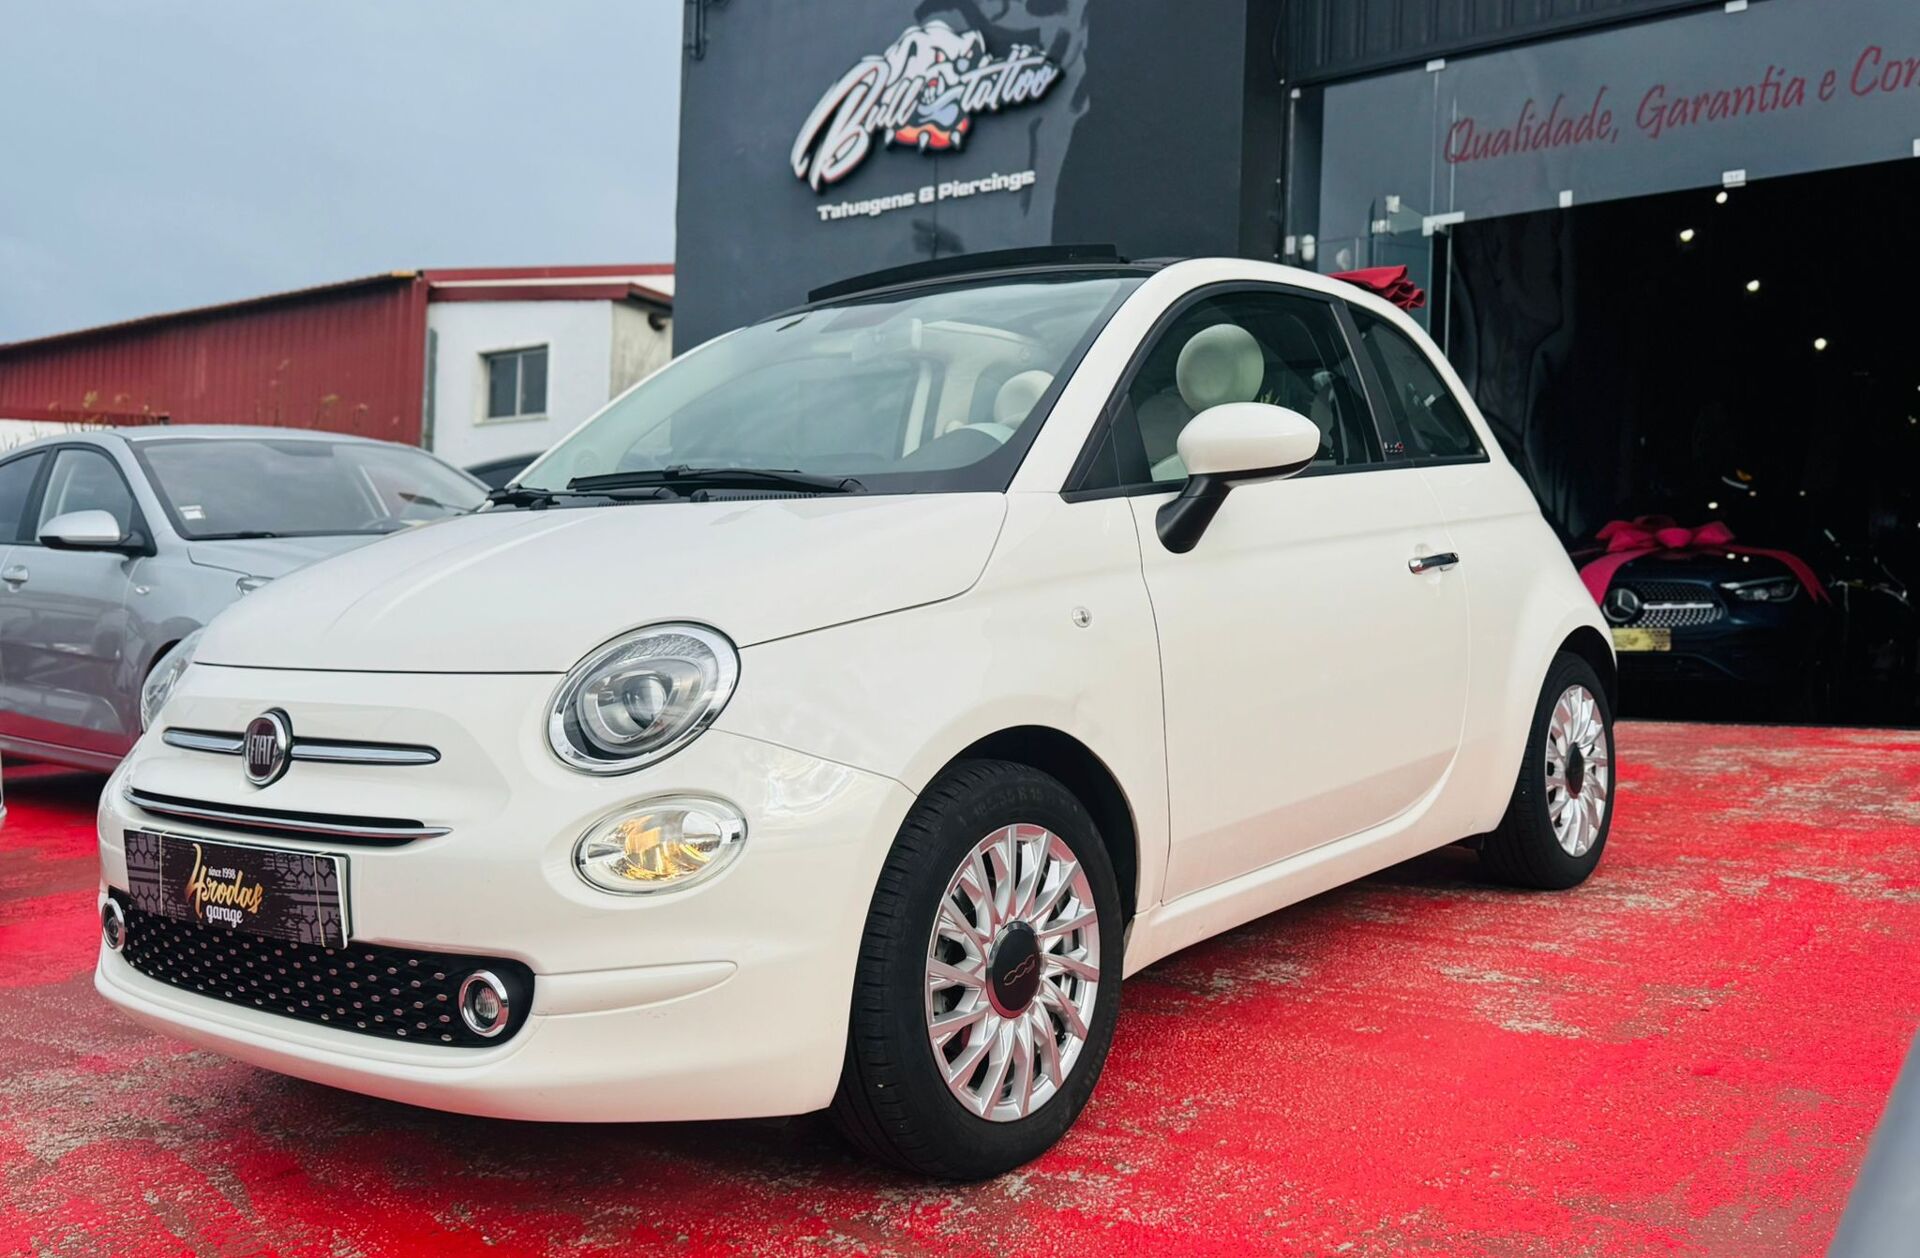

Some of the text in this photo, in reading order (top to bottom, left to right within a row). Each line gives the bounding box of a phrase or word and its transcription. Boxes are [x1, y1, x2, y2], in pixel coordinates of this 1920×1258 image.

[790, 56, 918, 191] Bull
[1443, 86, 1618, 163] Qualidade,
[1636, 64, 1805, 139] Garantia
[1818, 69, 1836, 101] e
[938, 170, 1036, 200] Piercings
[250, 734, 275, 765] FIAT
[208, 866, 222, 878] since
[206, 905, 243, 928] garage
